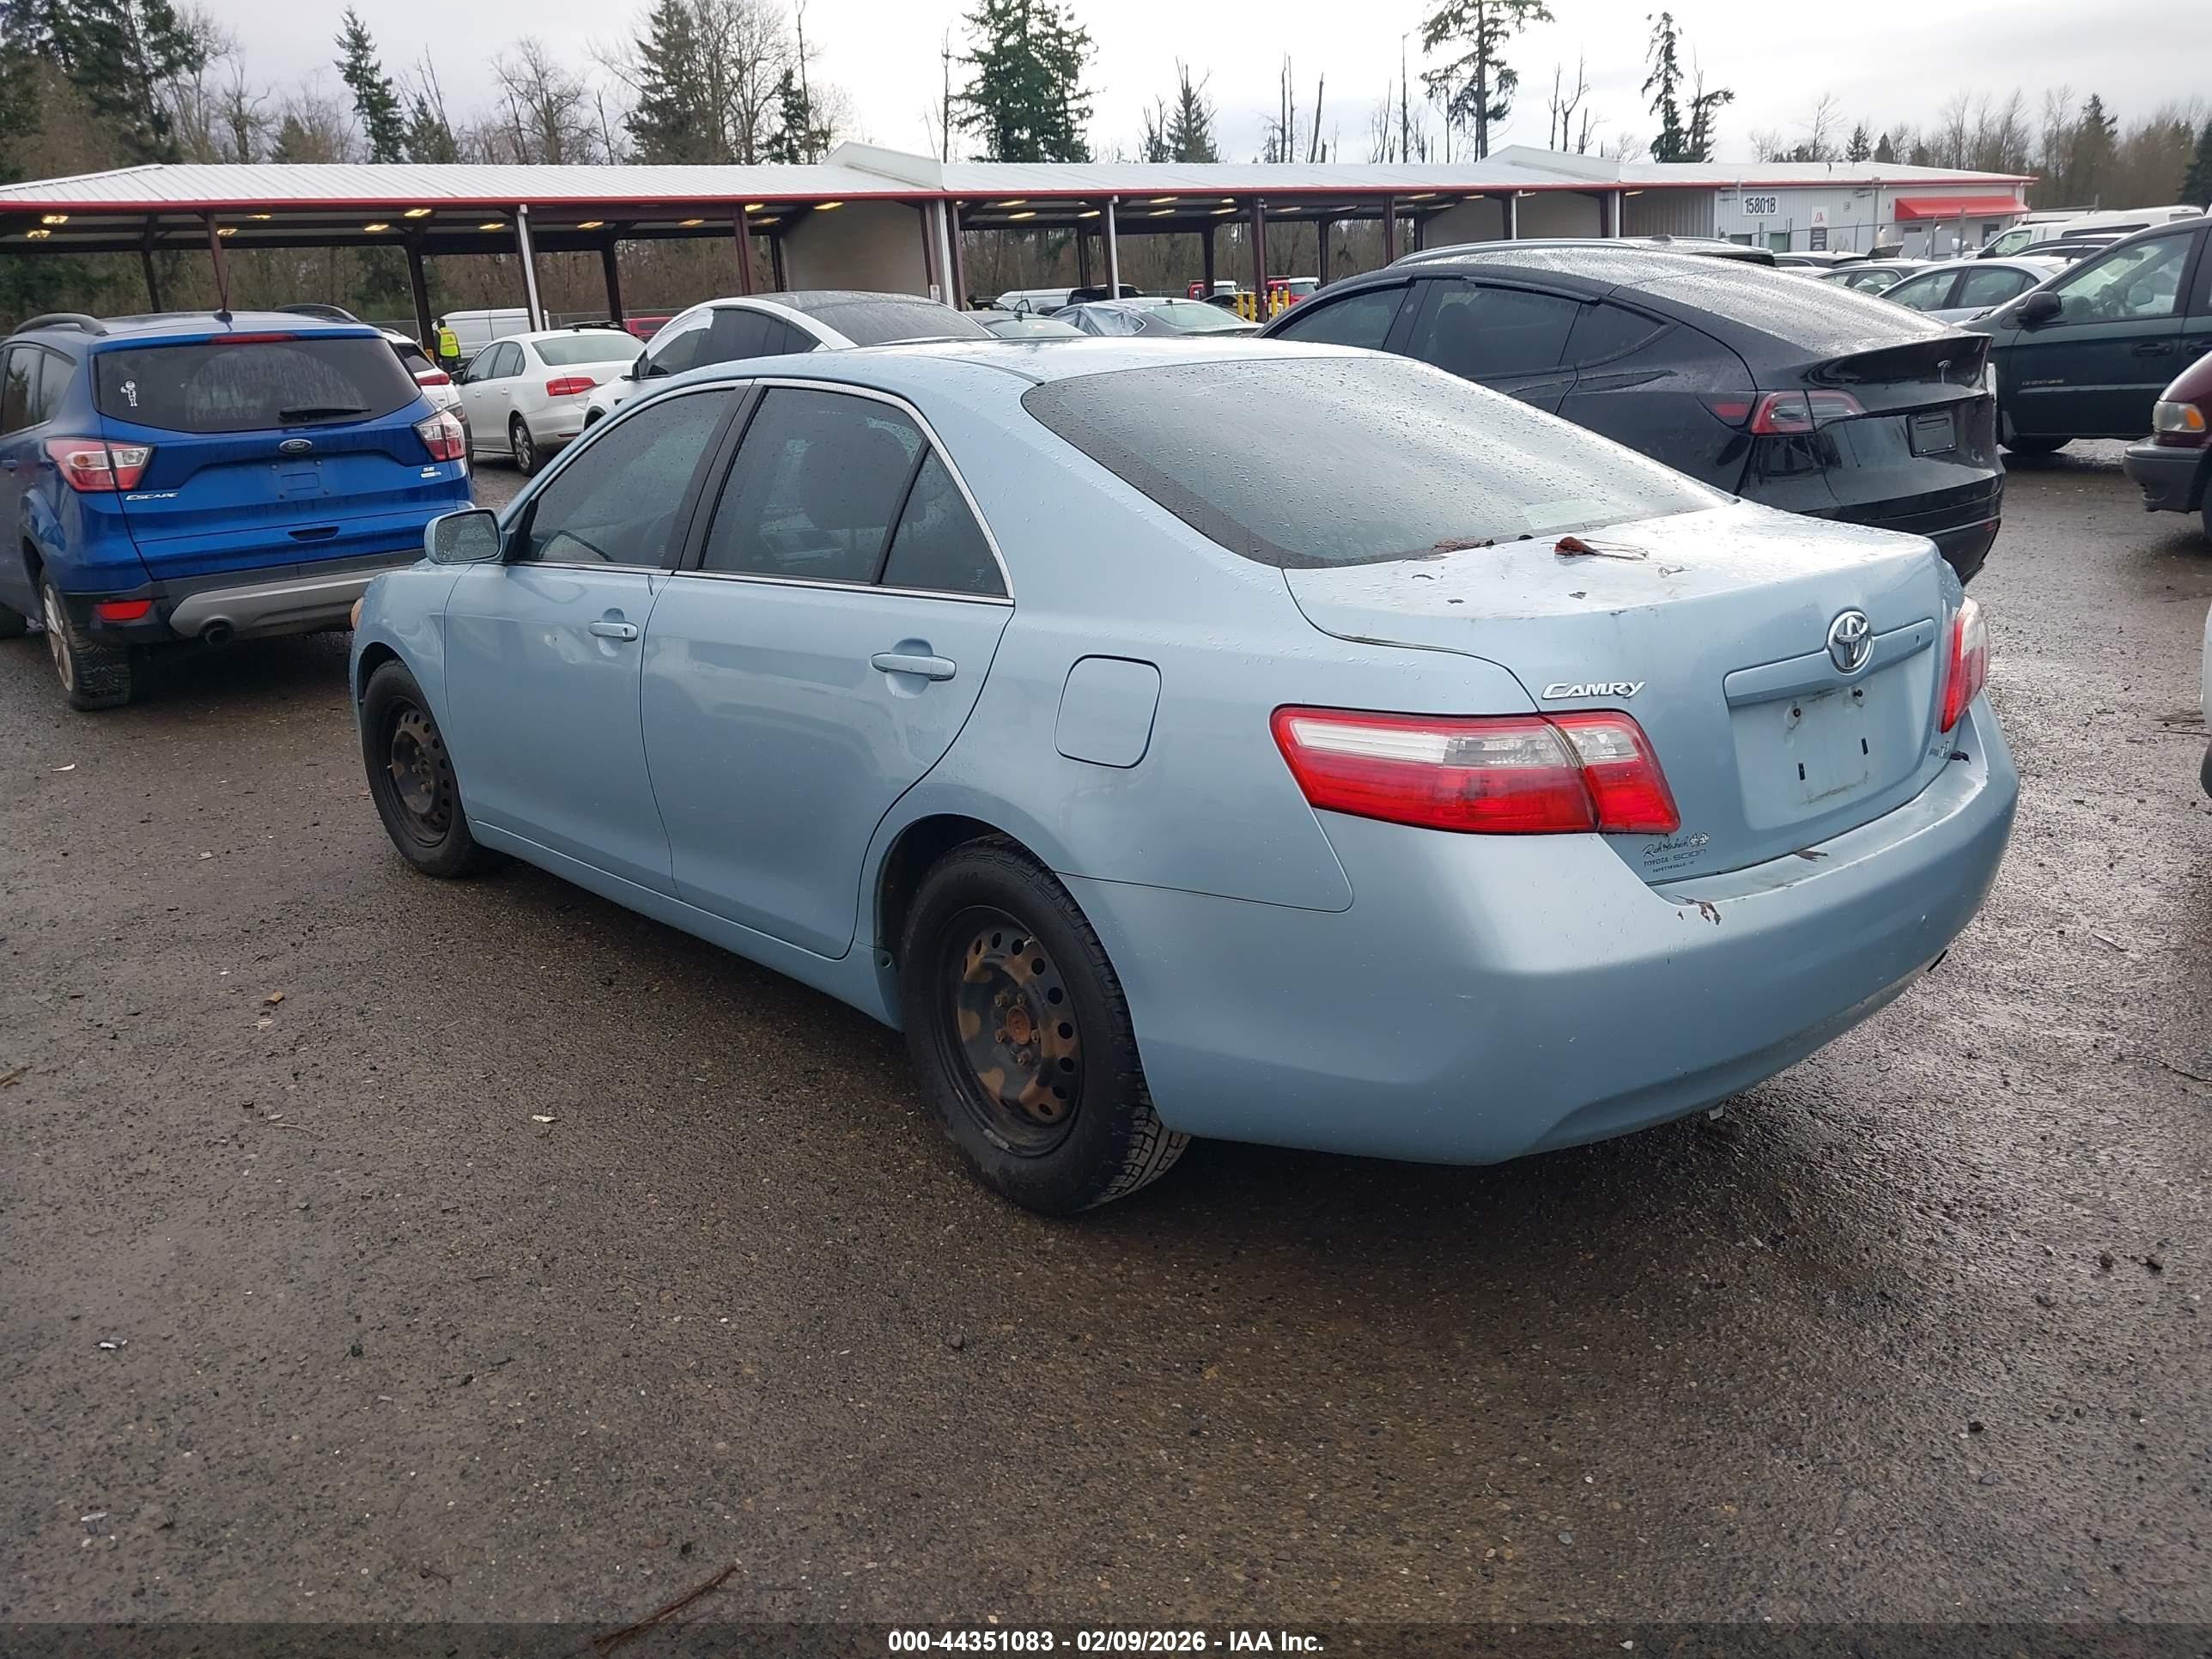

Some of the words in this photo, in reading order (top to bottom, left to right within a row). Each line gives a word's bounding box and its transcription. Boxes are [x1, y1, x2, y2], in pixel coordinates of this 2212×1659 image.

[1744, 197, 1777, 214] 15801B
[125, 492, 179, 501] ESCAPE
[1541, 681, 1646, 700] CAMRY
